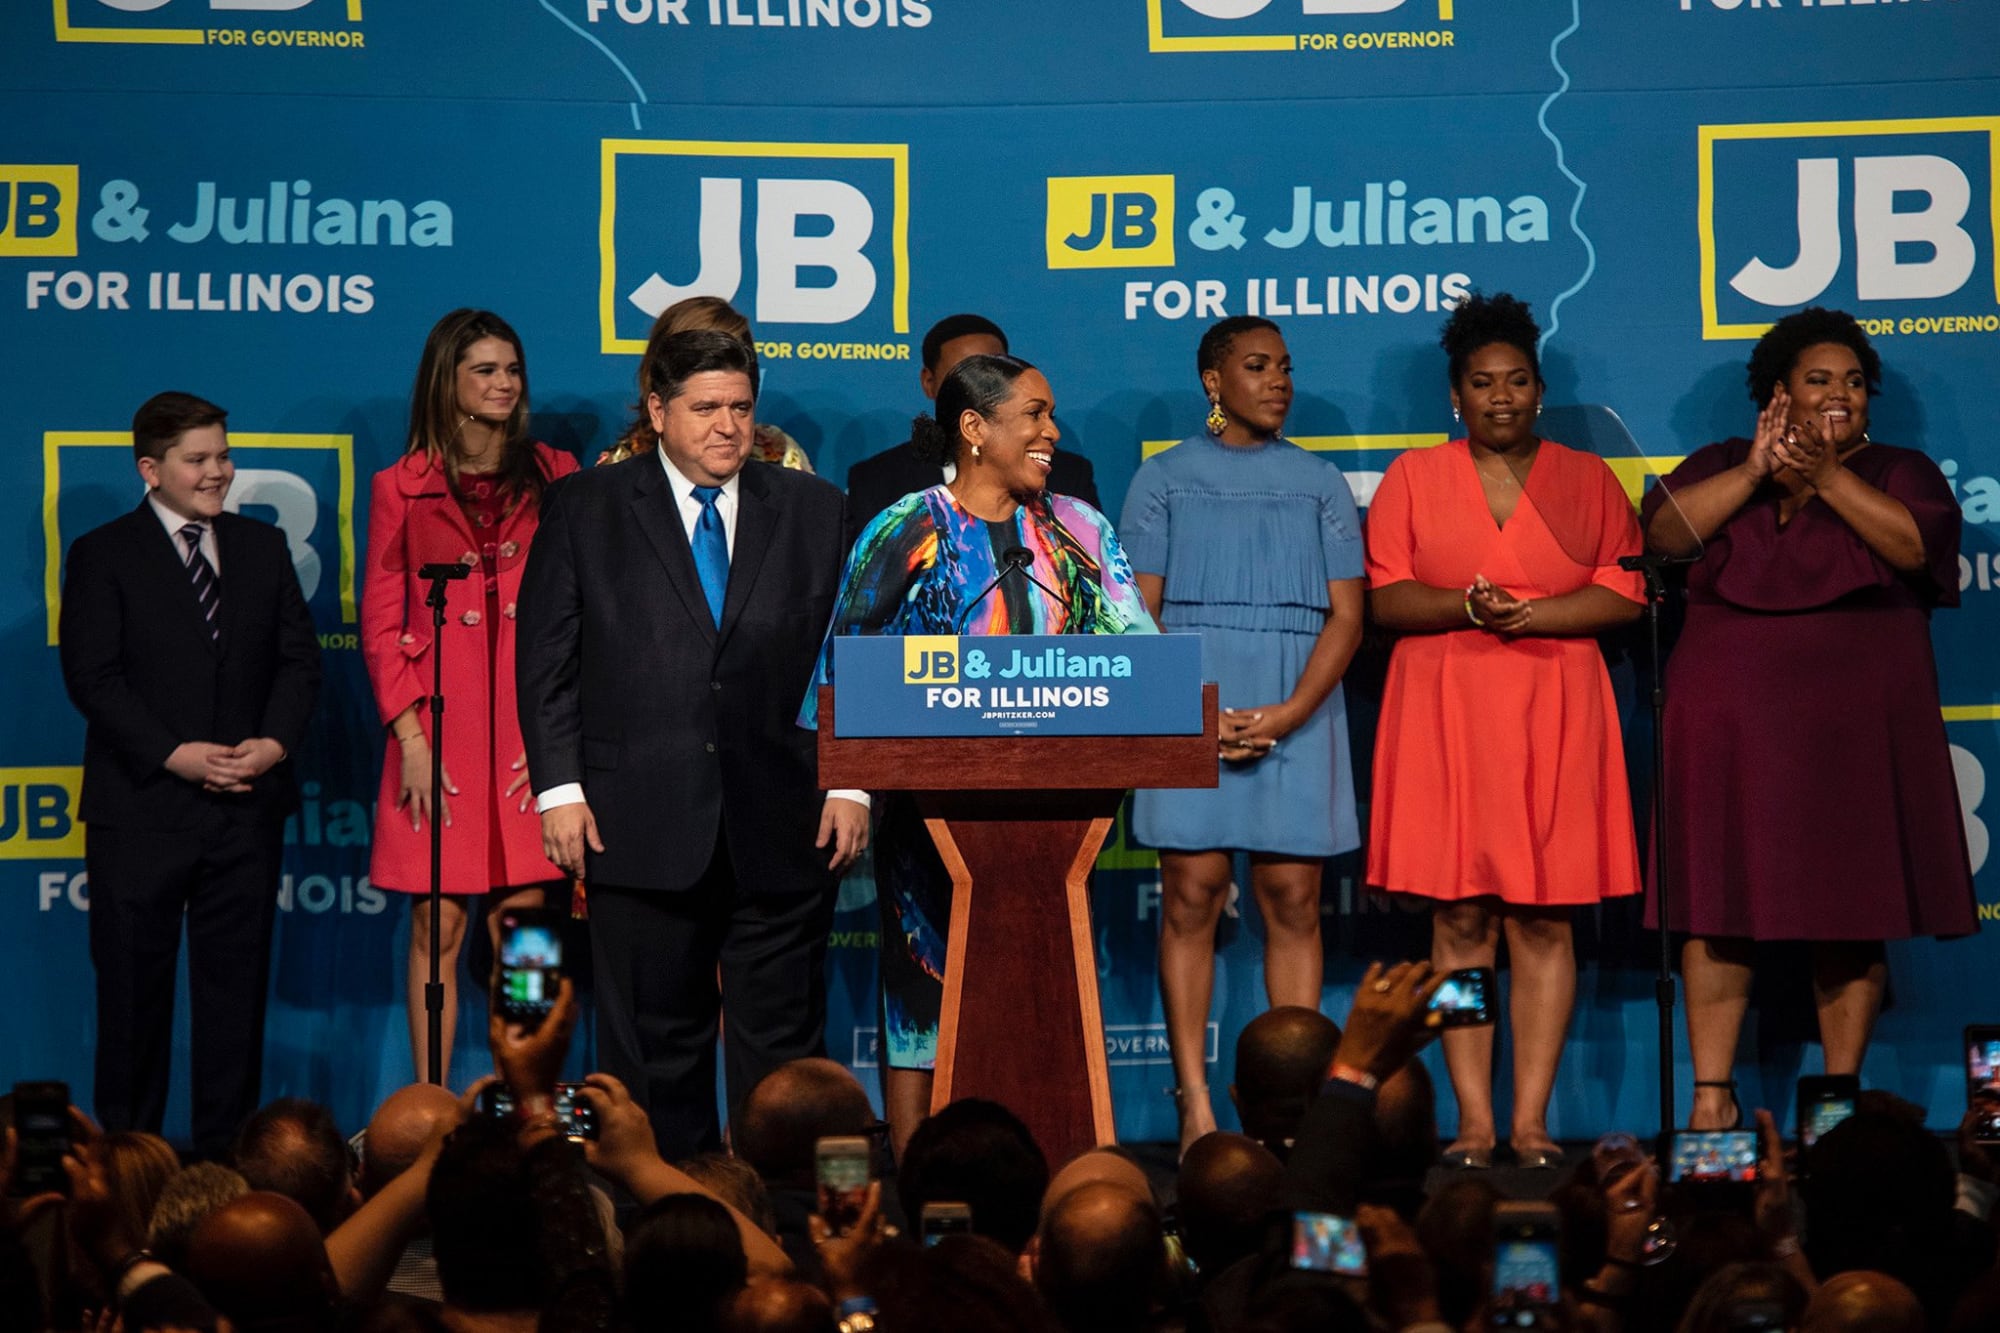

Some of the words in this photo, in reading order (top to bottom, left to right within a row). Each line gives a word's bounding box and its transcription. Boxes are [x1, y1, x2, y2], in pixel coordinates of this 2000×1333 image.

[587, 0, 690, 24] FOR
[709, 0, 933, 28] ILLINOIS
[208, 29, 247, 46] FOR
[251, 29, 365, 48] GOVERNOR
[1300, 34, 1338, 50] FOR
[1343, 31, 1454, 49] GOVERNOR
[92, 179, 150, 244] &
[167, 179, 454, 248] Juliana
[1064, 192, 1158, 252] JB
[1188, 187, 1247, 251] &
[1264, 180, 1550, 250] Juliana
[1729, 154, 1976, 306] JB
[628, 177, 877, 324] JB
[26, 271, 131, 310] FOR
[148, 272, 375, 314] ILLINOIS
[1124, 280, 1228, 320] FOR
[1246, 272, 1472, 316] ILLINOIS
[1899, 314, 2000, 335] GOVERNO
[797, 342, 910, 360] GOVERNOR
[908, 651, 955, 679] JB
[964, 649, 991, 680] &
[999, 648, 1132, 679] Juliana
[926, 688, 982, 708] FOR
[991, 686, 1110, 708] ILLINOIS
[981, 711, 1056, 719] JBPRITZKER.COM
